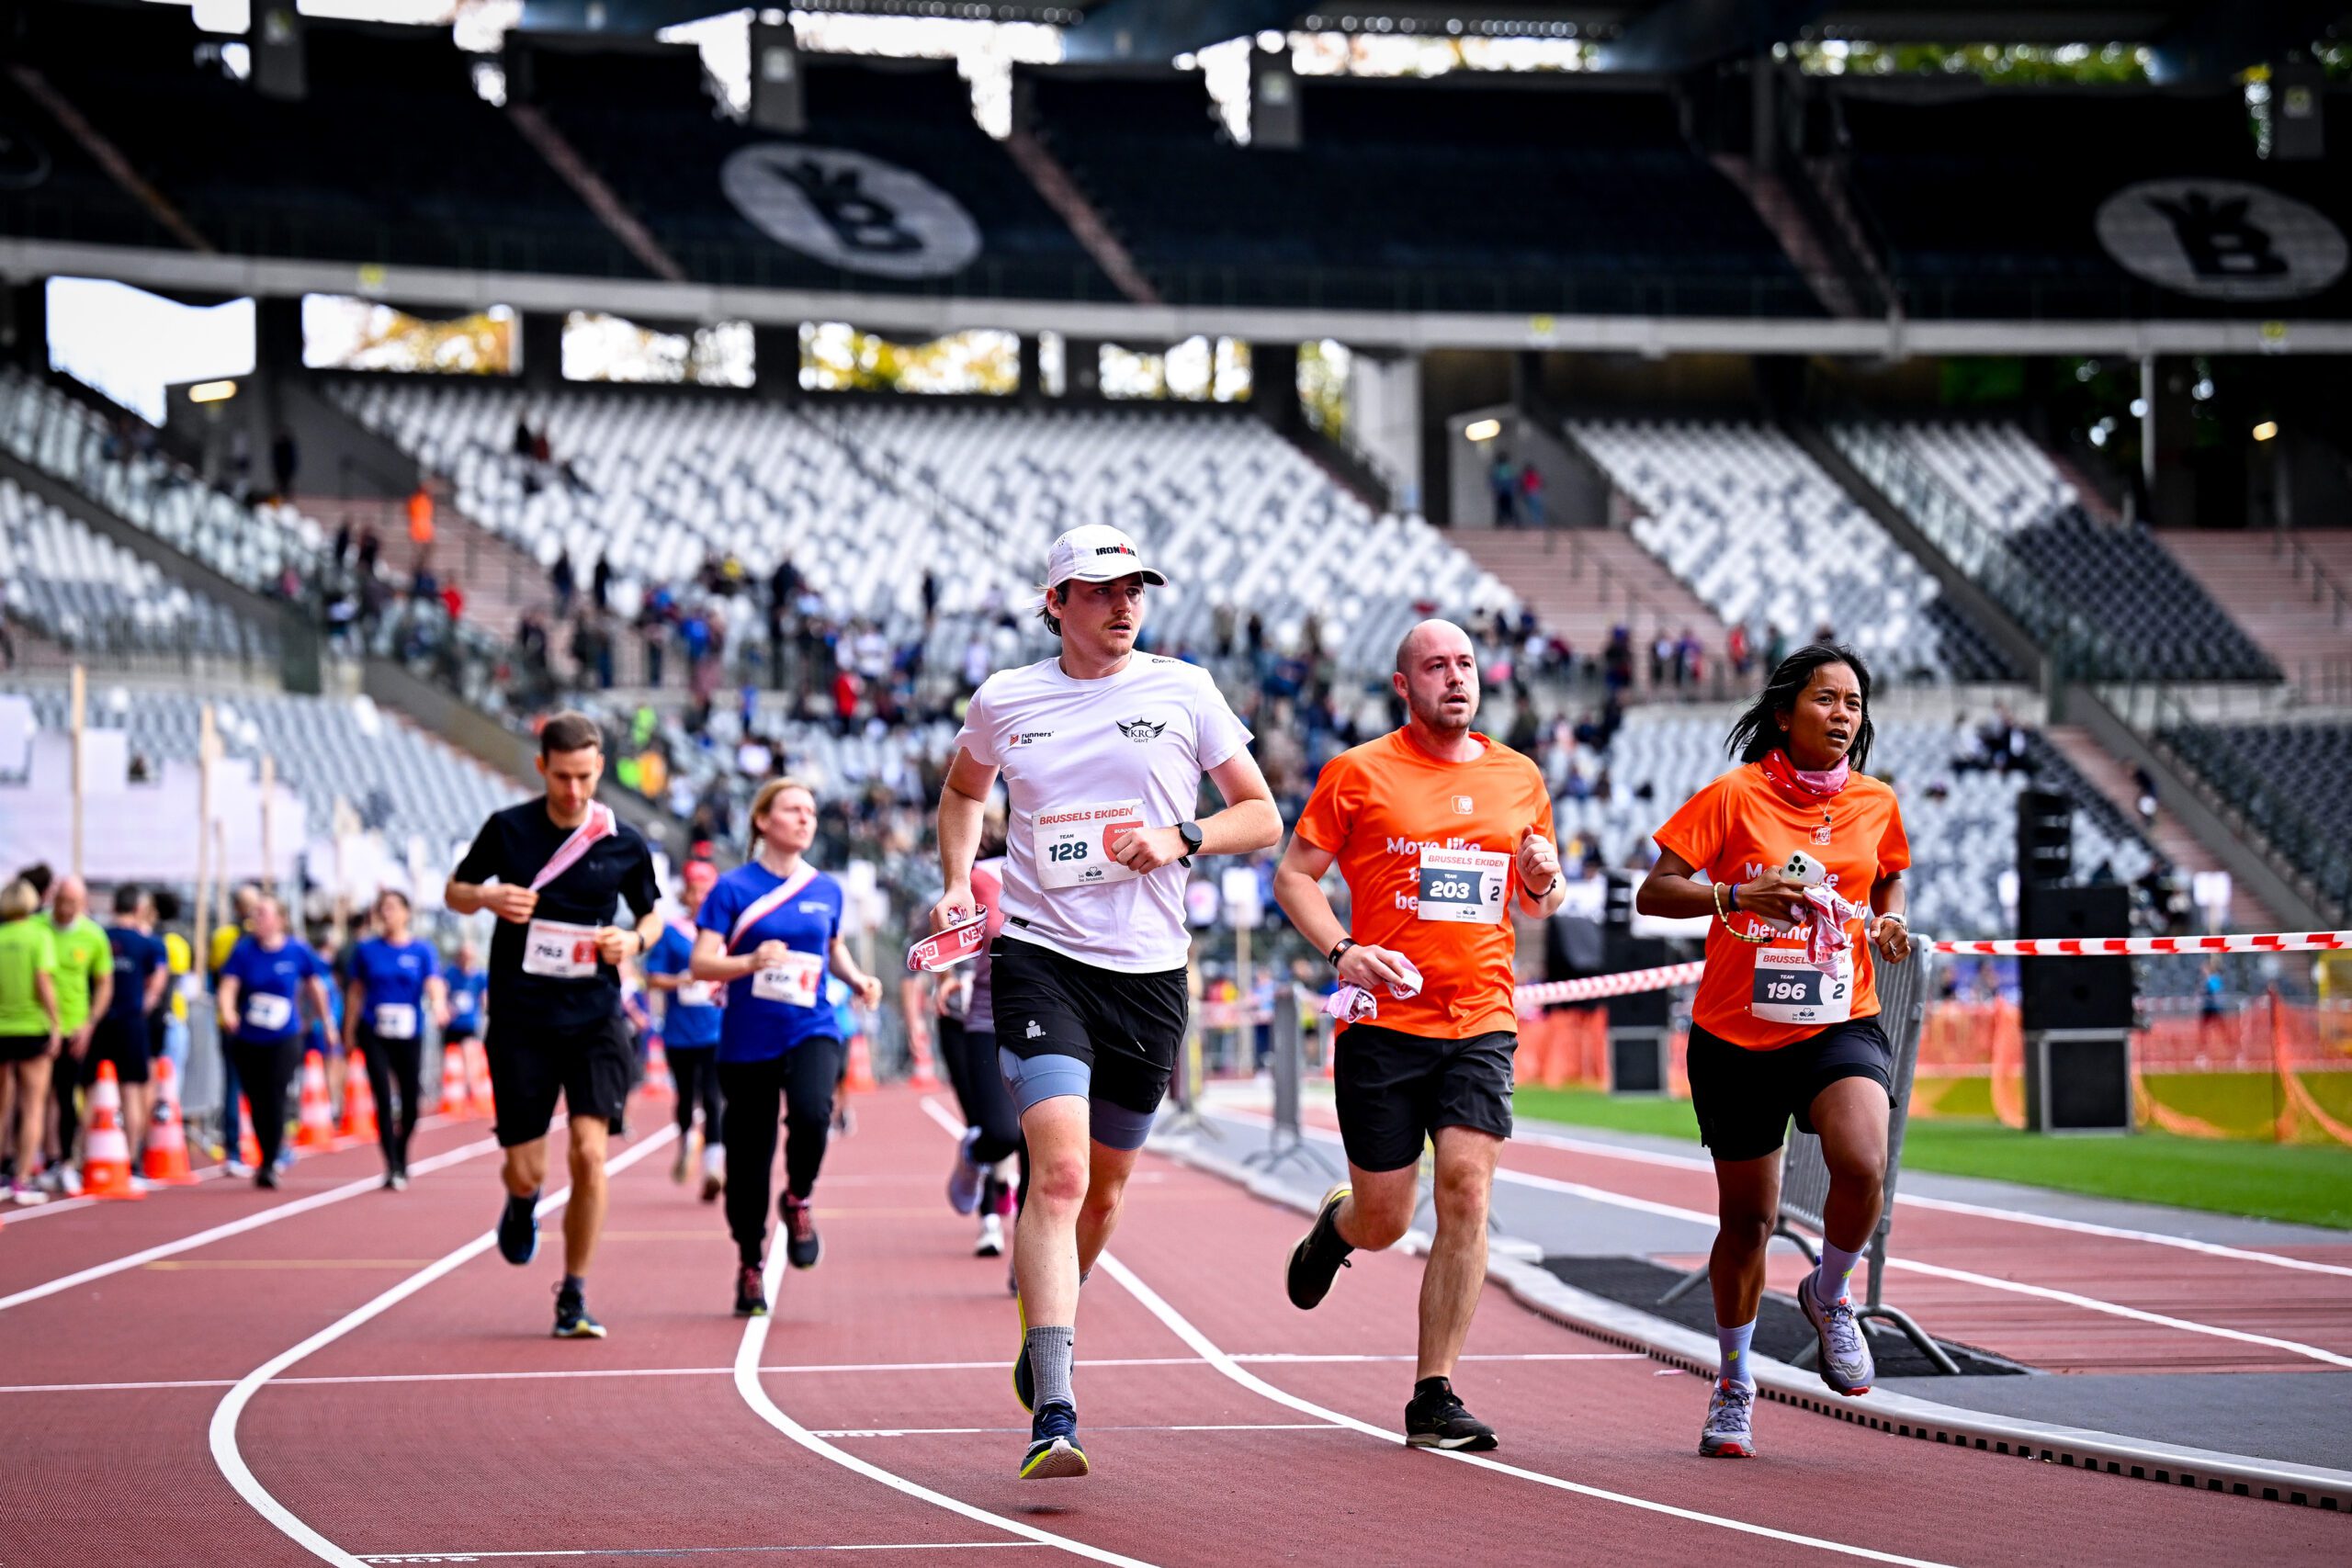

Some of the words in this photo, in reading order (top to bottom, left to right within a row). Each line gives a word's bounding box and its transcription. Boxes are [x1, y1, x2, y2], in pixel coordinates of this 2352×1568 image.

[1130, 729, 1153, 738] KRC
[1039, 811, 1091, 825] BRUSSELS
[1094, 807, 1134, 819] EKIDEN
[1048, 840, 1088, 862] 128
[1428, 854, 1473, 865] BRUSSELS
[1475, 858, 1505, 867] EKIDEN
[1429, 880, 1471, 899] 203
[1489, 886, 1500, 902] 2
[1762, 954, 1810, 964] BRUSSEL
[1767, 982, 1807, 1000] 196
[1832, 983, 1846, 999] 2
